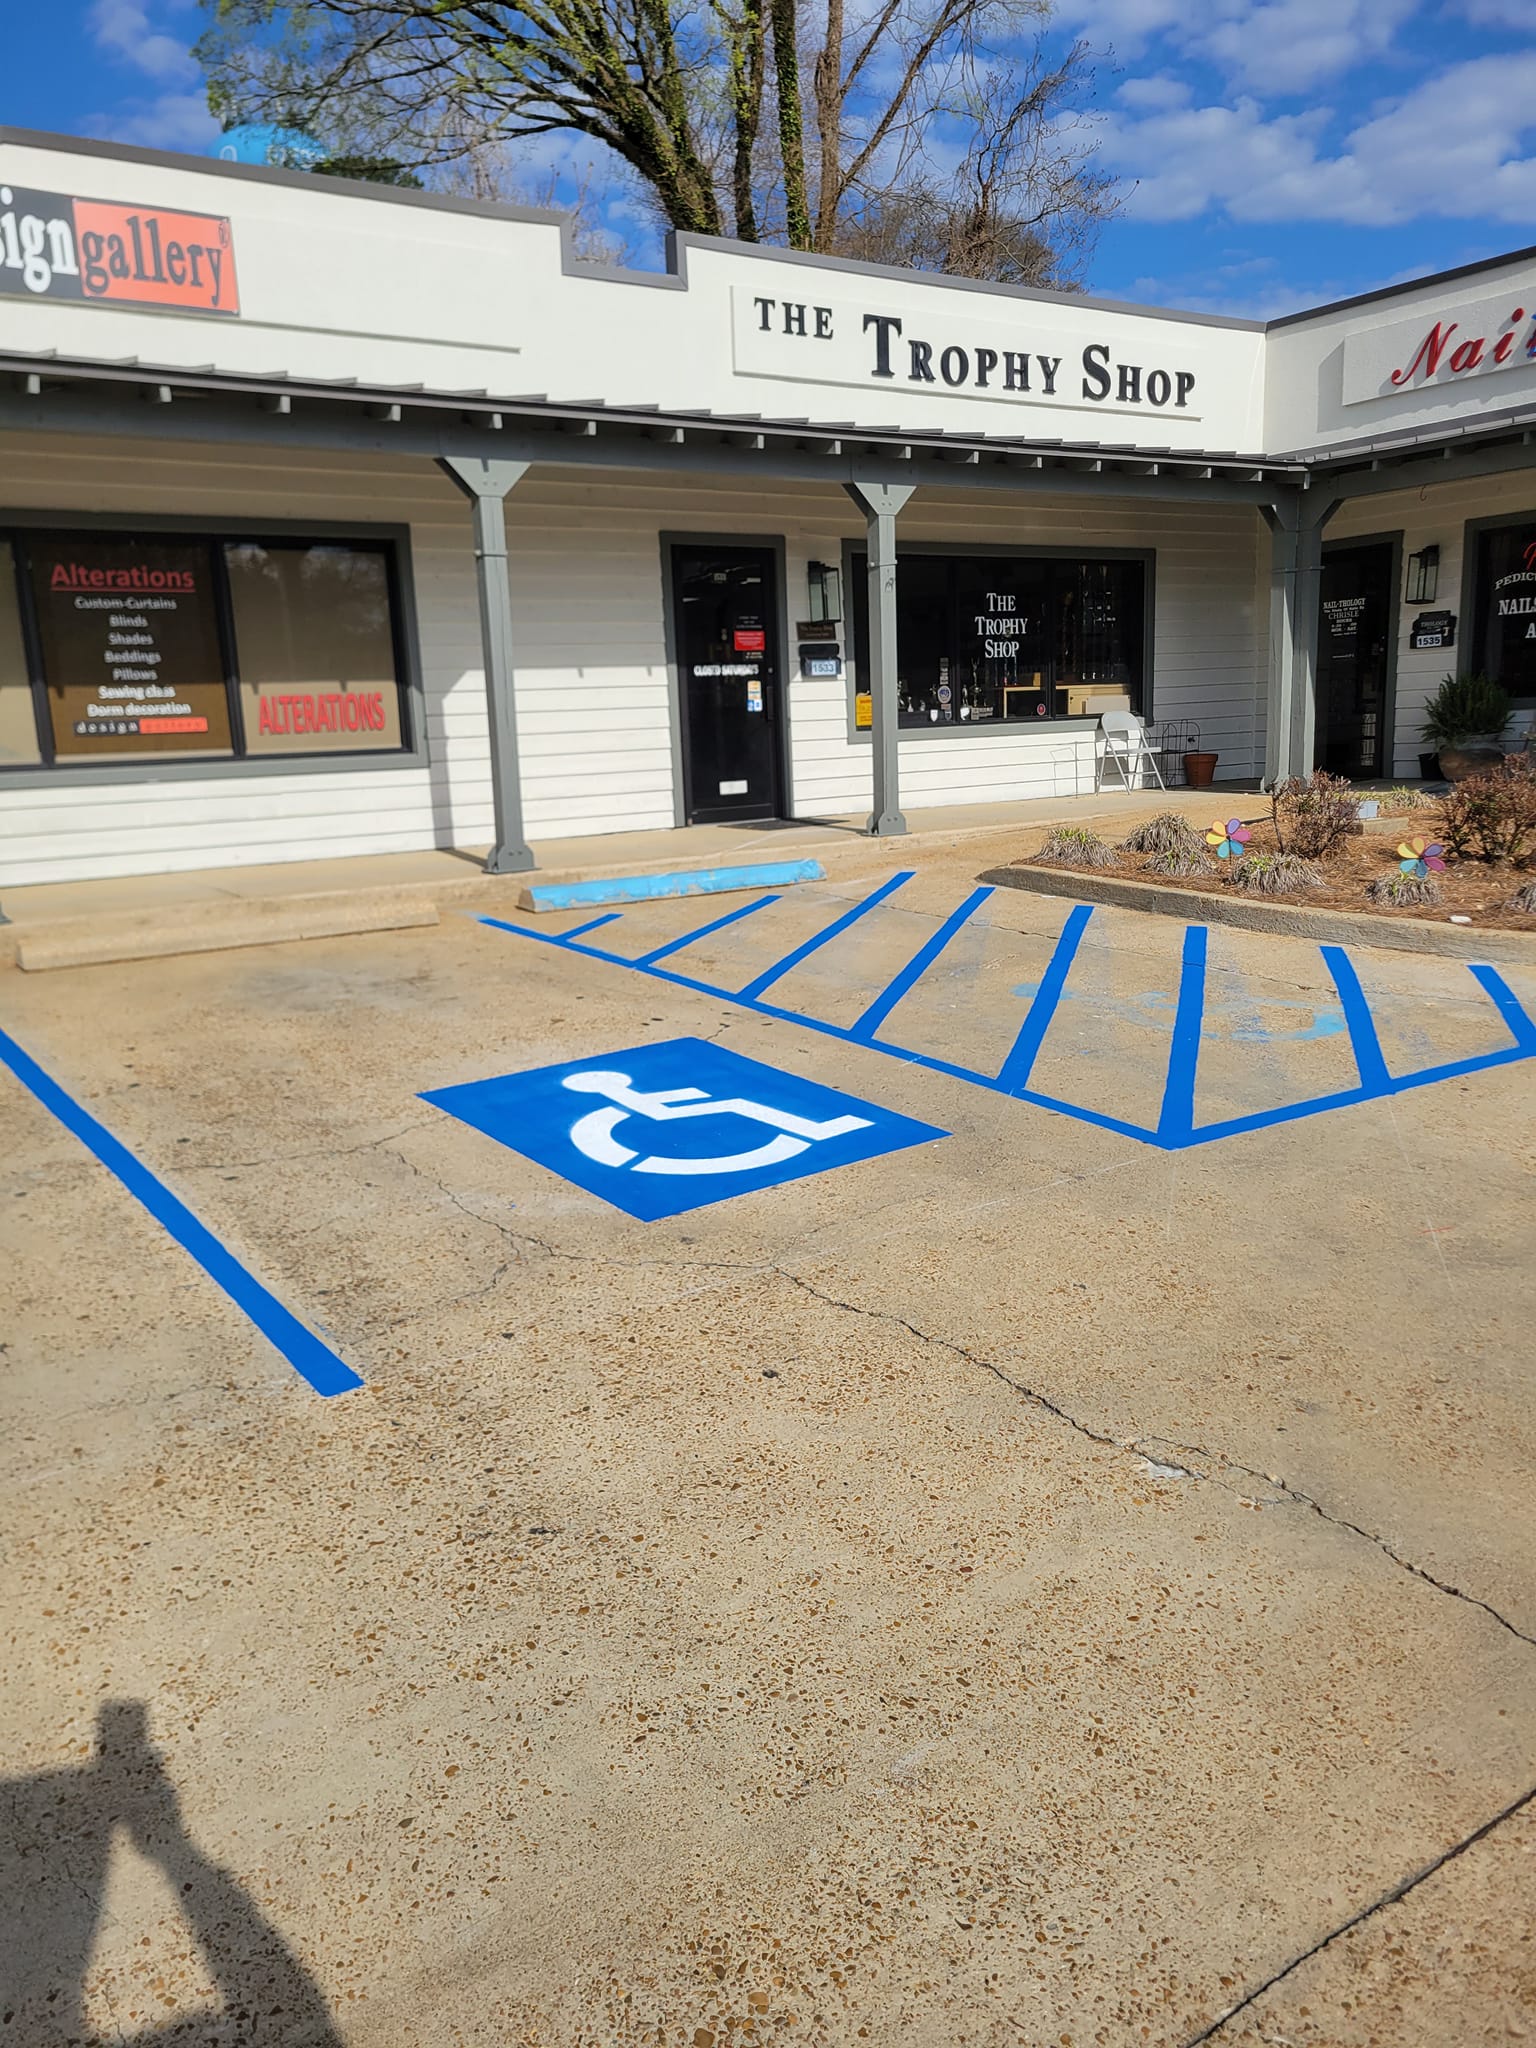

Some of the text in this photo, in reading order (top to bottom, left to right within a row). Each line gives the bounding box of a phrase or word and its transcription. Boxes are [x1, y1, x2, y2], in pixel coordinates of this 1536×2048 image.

[0, 186, 222, 307] ign gallery
[754, 296, 1197, 408] THE TROPHY SHOP
[1391, 307, 1536, 386] Nai
[51, 563, 196, 588] Alterations
[1494, 572, 1536, 591] PEDIC
[986, 592, 1017, 612] THE
[109, 614, 149, 627] Blinds
[974, 615, 1029, 636] TROPHY
[108, 632, 154, 645] Shades
[1418, 636, 1441, 646] 1535
[104, 650, 162, 665] Beddings
[984, 639, 1020, 659] SHOP
[112, 668, 158, 681] Pillows
[813, 663, 834, 673] 1533
[98, 685, 145, 701] Sewing
[87, 702, 192, 717] Dorm decoration
[259, 692, 386, 736] ALTERATIONS
